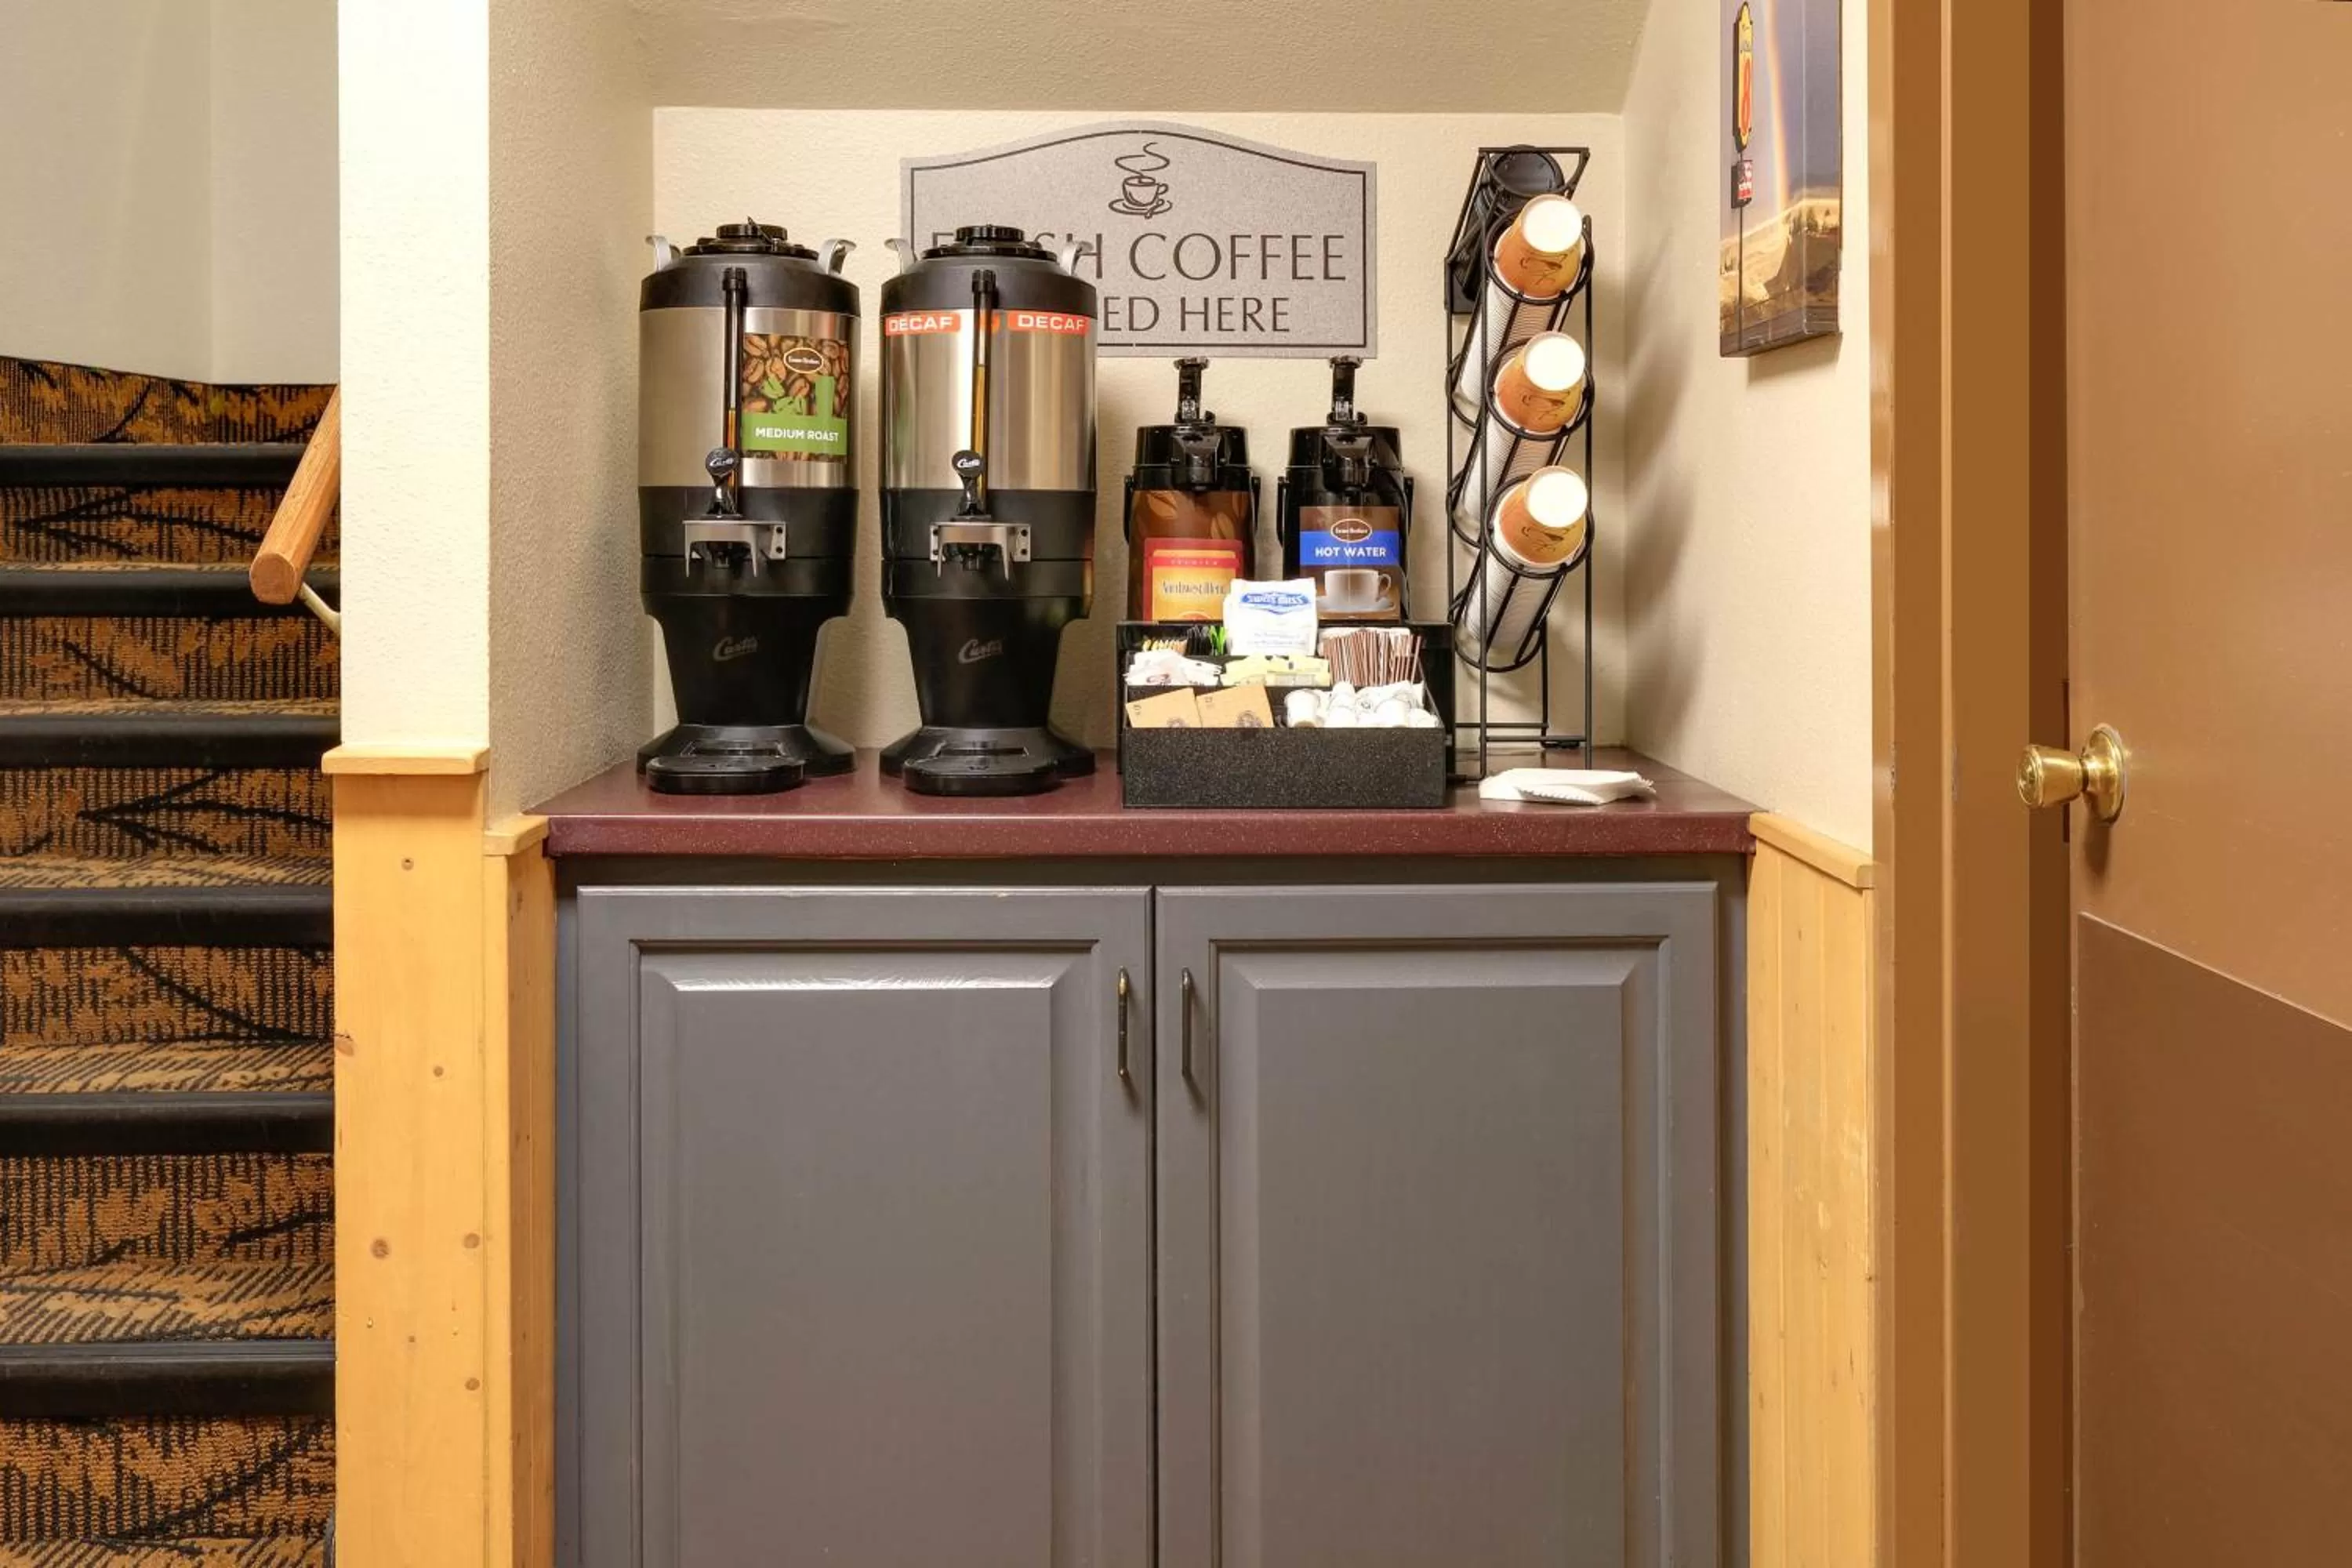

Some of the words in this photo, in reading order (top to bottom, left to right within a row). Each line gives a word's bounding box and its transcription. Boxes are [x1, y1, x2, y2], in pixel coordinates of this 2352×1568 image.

[1129, 233, 1347, 281] COFFEE
[1018, 314, 1086, 331] DECAF
[1181, 296, 1290, 332] HERE
[888, 315, 954, 332] DECAF
[755, 427, 805, 440] MEDIUM
[806, 430, 839, 442] ROAST
[1315, 546, 1339, 557] HOT
[1343, 546, 1387, 557] WATER
